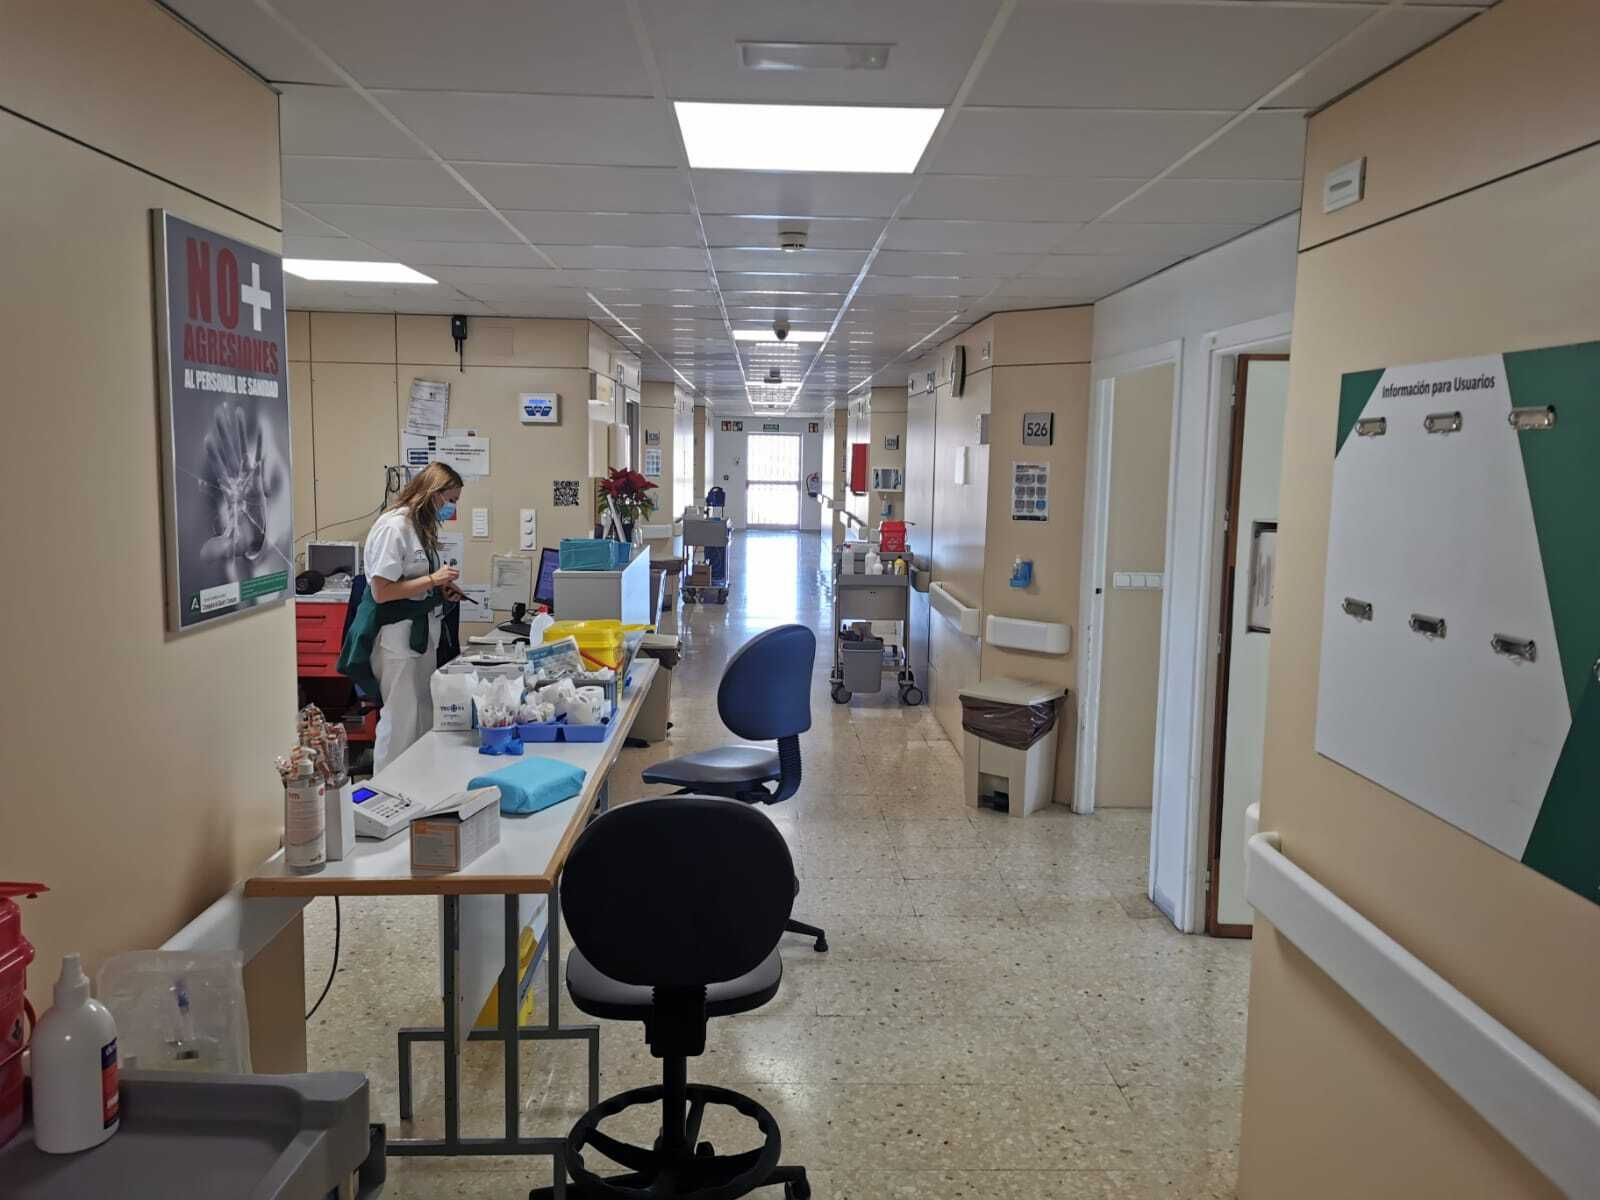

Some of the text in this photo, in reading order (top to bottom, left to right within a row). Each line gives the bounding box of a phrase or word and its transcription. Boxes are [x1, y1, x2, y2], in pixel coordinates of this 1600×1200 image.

[184, 323, 279, 375] AGRESIONES
[184, 368, 279, 398] AL PERSONAL DE SANIDAD
[1382, 373, 1496, 398] Información para Usuarios
[1026, 422, 1048, 437] 526
